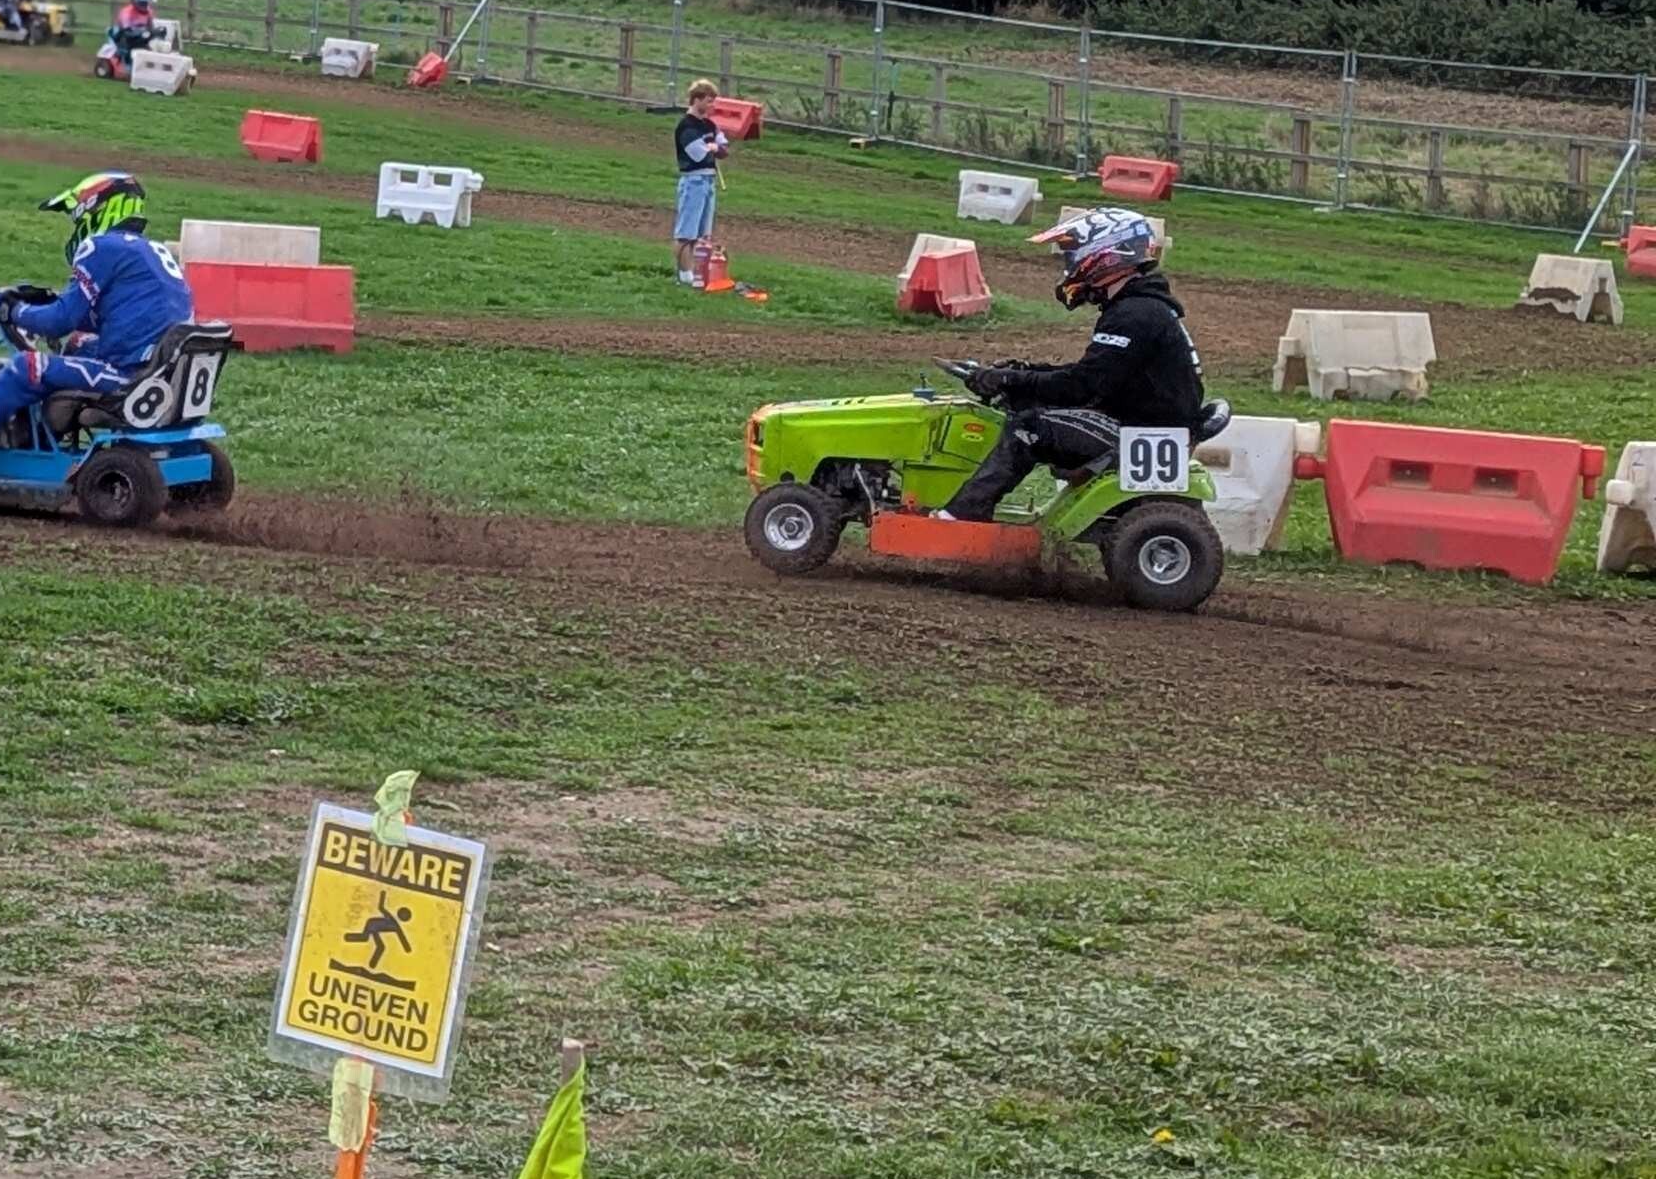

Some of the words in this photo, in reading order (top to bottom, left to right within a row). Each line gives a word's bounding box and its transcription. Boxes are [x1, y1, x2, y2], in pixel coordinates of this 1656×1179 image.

[148, 240, 184, 280] 8
[132, 386, 164, 420] 8
[190, 367, 211, 407] 8
[1130, 438, 1179, 483] 99
[323, 829, 465, 895] BEWARE
[309, 972, 429, 1025] UNEVEN
[298, 999, 428, 1053] GROUND
